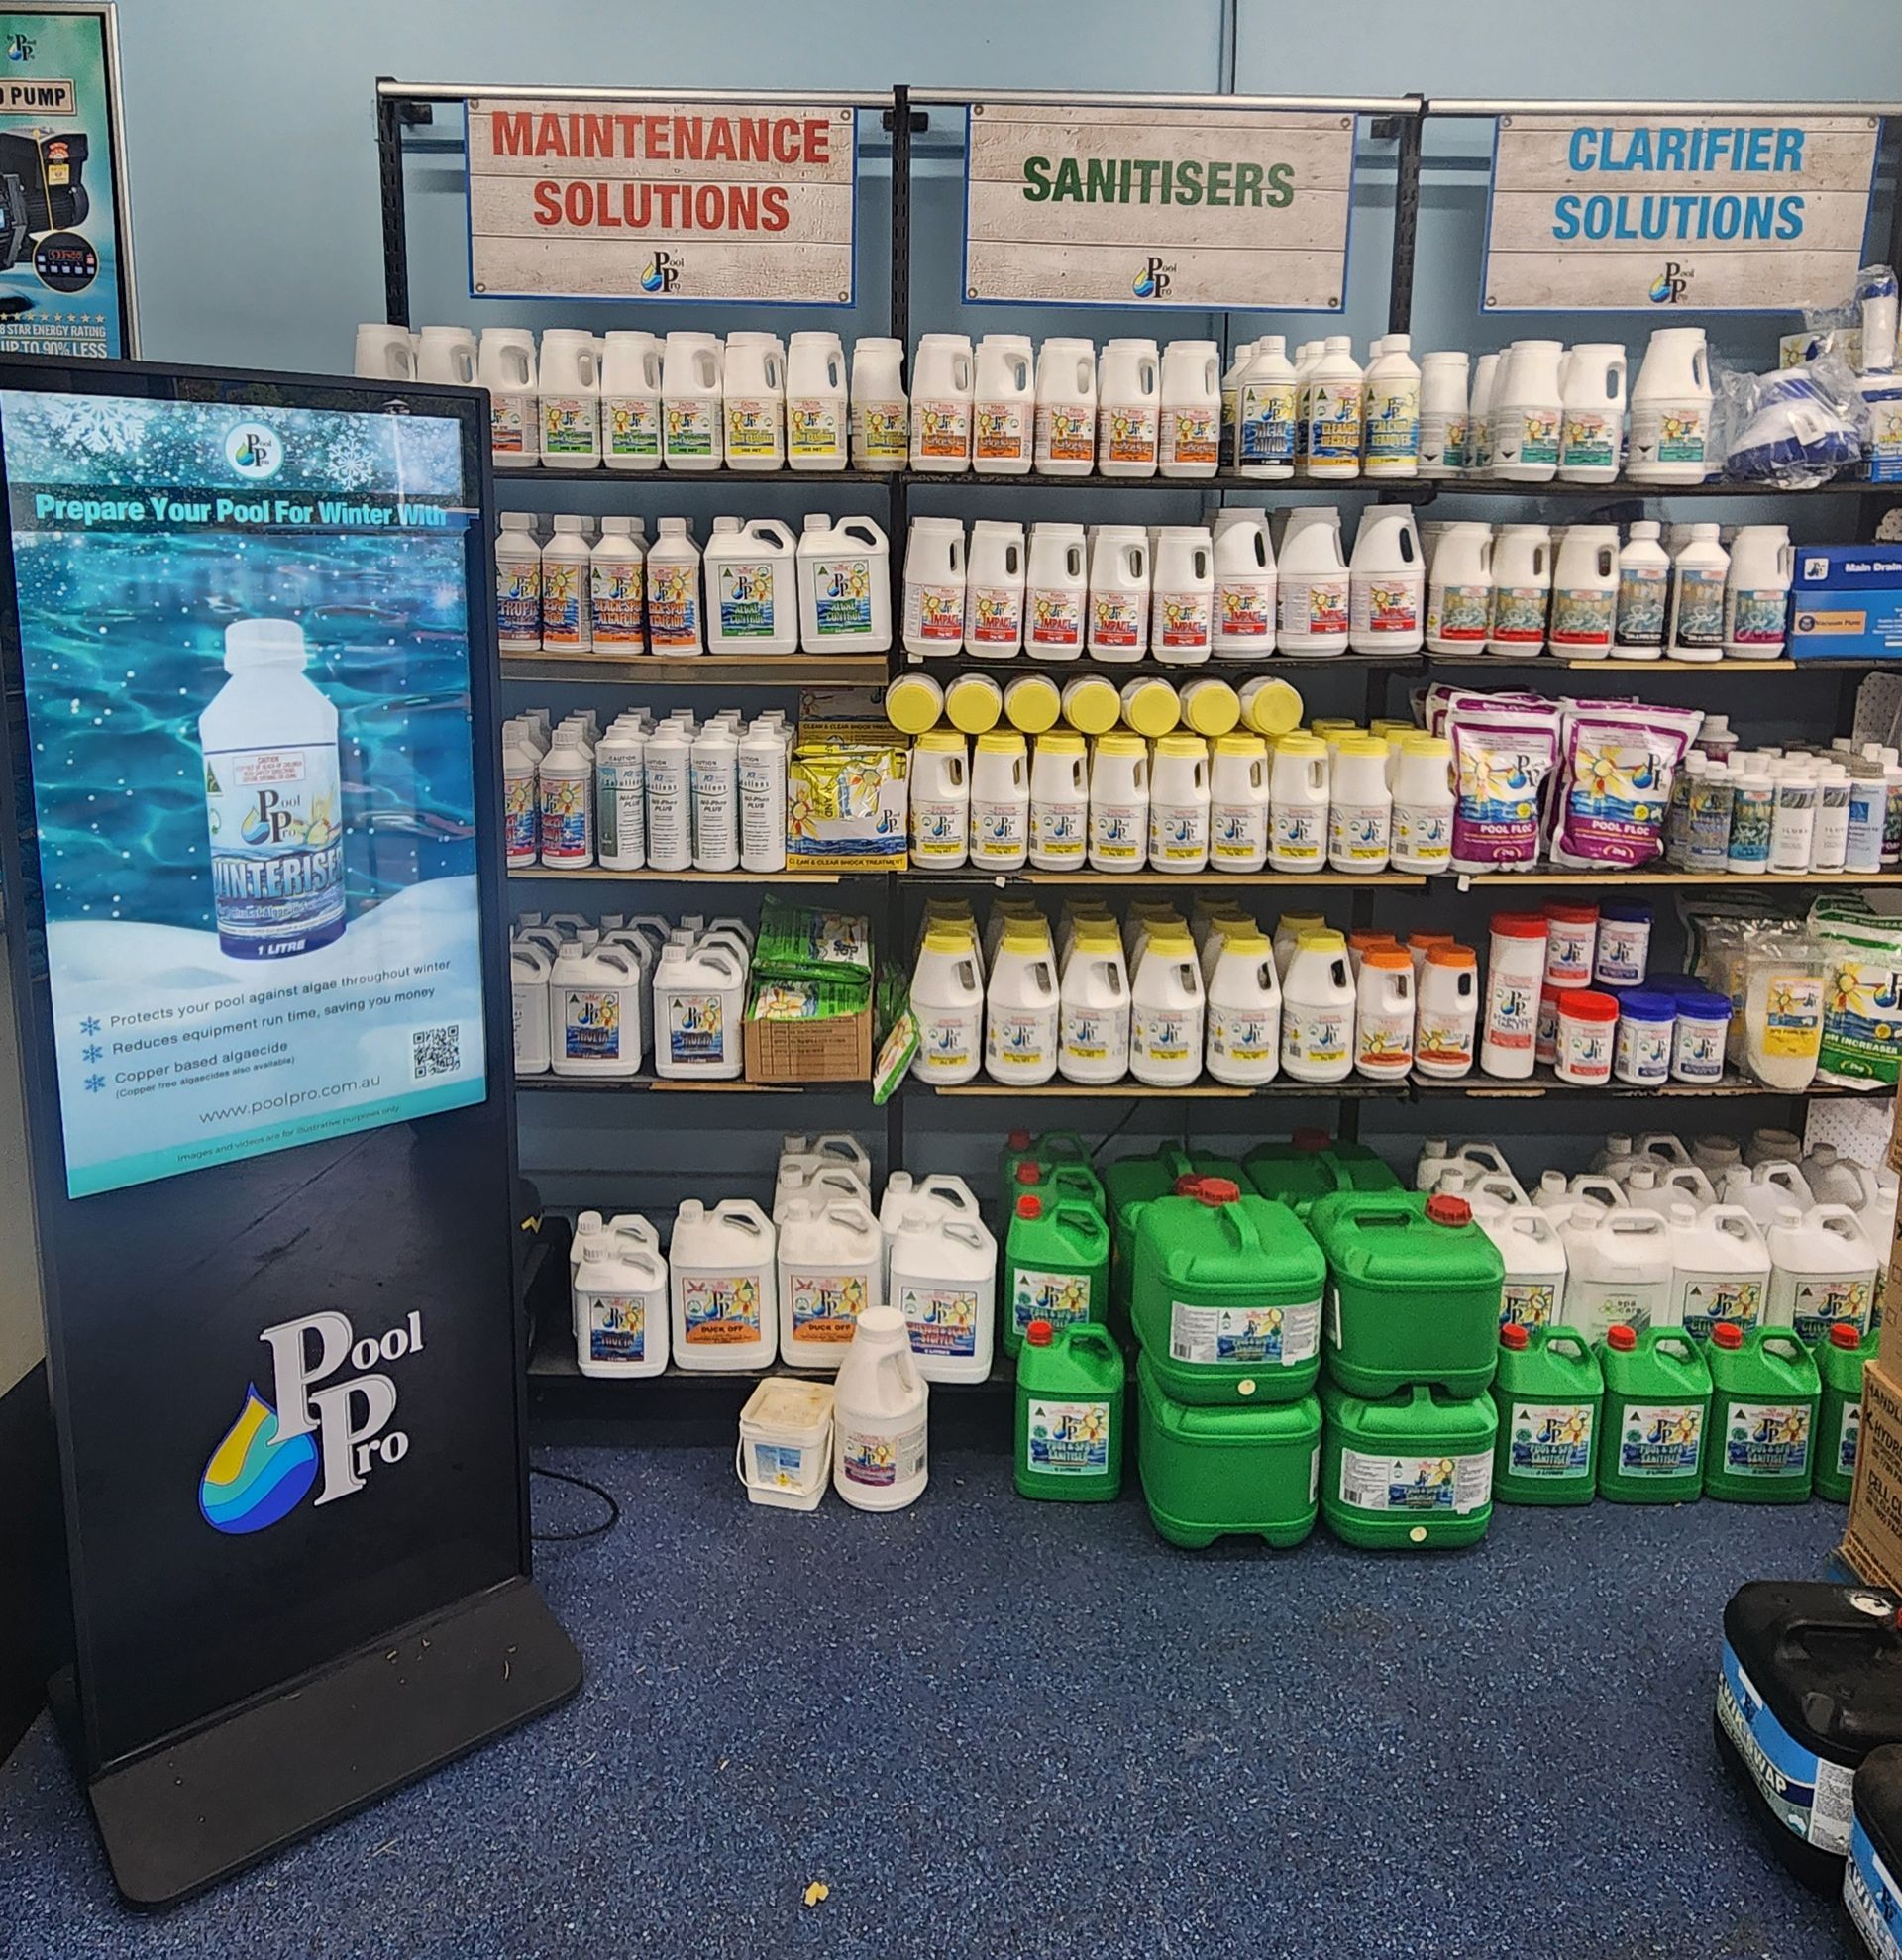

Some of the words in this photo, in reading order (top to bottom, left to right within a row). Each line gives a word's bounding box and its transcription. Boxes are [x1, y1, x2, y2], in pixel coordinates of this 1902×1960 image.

[11, 86, 66, 106] PUMP
[492, 111, 829, 164] MAINTENANCE
[1569, 127, 1805, 172] CLARIFIER
[1023, 156, 1295, 208] SANITISERS
[534, 180, 790, 231] SOLUTIONS
[1552, 195, 1805, 240] SOLUTIONS
[7, 324, 31, 334] STAR
[33, 324, 69, 336] ENERGY
[71, 326, 106, 338] RATING
[73, 342, 107, 359] LESS
[36, 494, 145, 526] Prepare
[150, 497, 211, 524] Your
[216, 499, 269, 524] Pool
[275, 501, 313, 524] For
[318, 503, 393, 526] Winter
[398, 504, 447, 526] With
[1845, 563, 1871, 572] Main
[1873, 562, 1902, 571] Drain
[930, 614, 959, 626] IMPACT
[983, 616, 1011, 628] IMPACT
[1040, 617, 1071, 630] IMPACT
[1100, 620, 1131, 632] IMPACT
[257, 790, 301, 822] Pool
[269, 811, 296, 842] Pro
[1480, 823, 1510, 834] POOL
[1511, 824, 1533, 834] FLOC
[1592, 820, 1623, 834] POOL
[1624, 825, 1650, 836] FLOC
[258, 945, 264, 956] 1
[267, 939, 306, 955] LITRE
[110, 1009, 174, 1028] Protects
[177, 1001, 210, 1019] your
[214, 994, 245, 1012] pool
[249, 986, 298, 1005] against
[302, 980, 337, 997] algae
[341, 967, 410, 986] throughout
[413, 960, 451, 976] winter
[113, 1035, 178, 1055] Reduces
[182, 1019, 258, 1041] equipment
[262, 1014, 283, 1026] run
[287, 1007, 321, 1023] time,
[324, 1000, 366, 1016] saving
[369, 994, 391, 1010] you
[395, 987, 435, 1003] money
[1840, 1035, 1898, 1054] INCREASER
[115, 1064, 170, 1083] Copper
[174, 1054, 218, 1073] based
[222, 1041, 287, 1067] algaecide
[116, 1084, 156, 1099] (Copper
[158, 1080, 177, 1090] free
[179, 1070, 230, 1087] algaecides
[232, 1066, 251, 1077] also
[253, 1056, 295, 1072] available)
[199, 1076, 381, 1124] www.poolpro.com.au
[177, 1149, 213, 1163] Images
[215, 1143, 234, 1154] and
[235, 1136, 264, 1149] videos
[265, 1132, 281, 1141] are
[282, 1128, 295, 1138] for
[296, 1118, 341, 1134] illustrative
[343, 1109, 380, 1126] purposes
[260, 1311, 423, 1446] Pool
[308, 1374, 409, 1506] Pro
